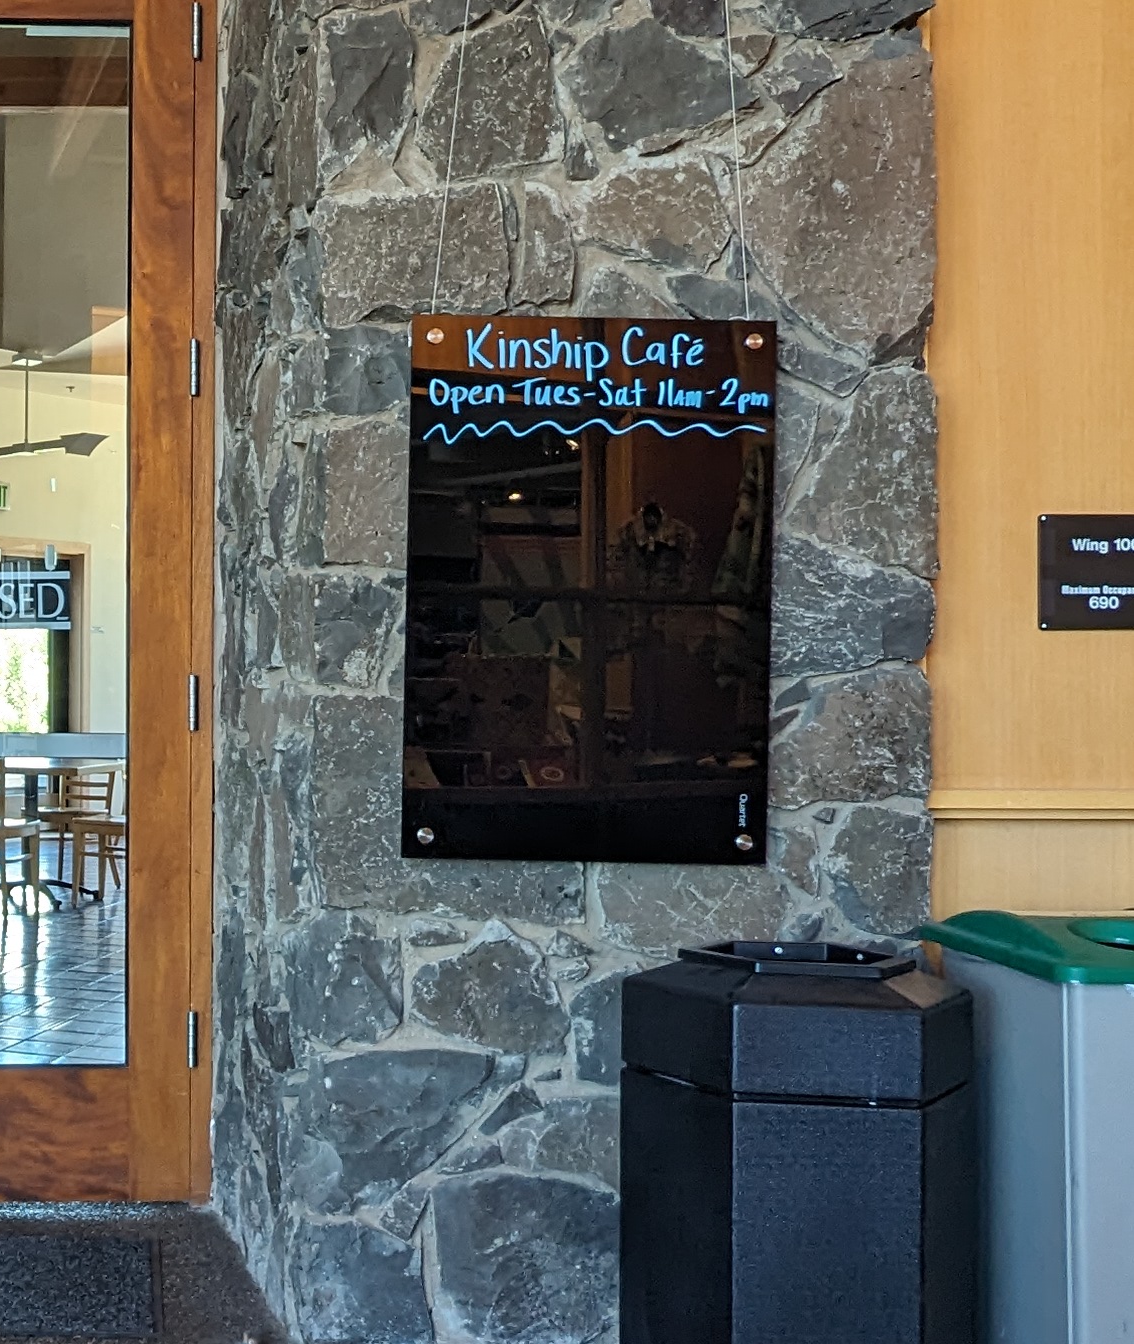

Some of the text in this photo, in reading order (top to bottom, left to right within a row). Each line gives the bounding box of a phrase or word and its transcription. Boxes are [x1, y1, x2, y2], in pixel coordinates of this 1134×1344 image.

[466, 323, 704, 381] Kinship Café
[429, 378, 505, 414] Open
[1071, 537, 1109, 555] Wing
[1088, 596, 1120, 610] 690
